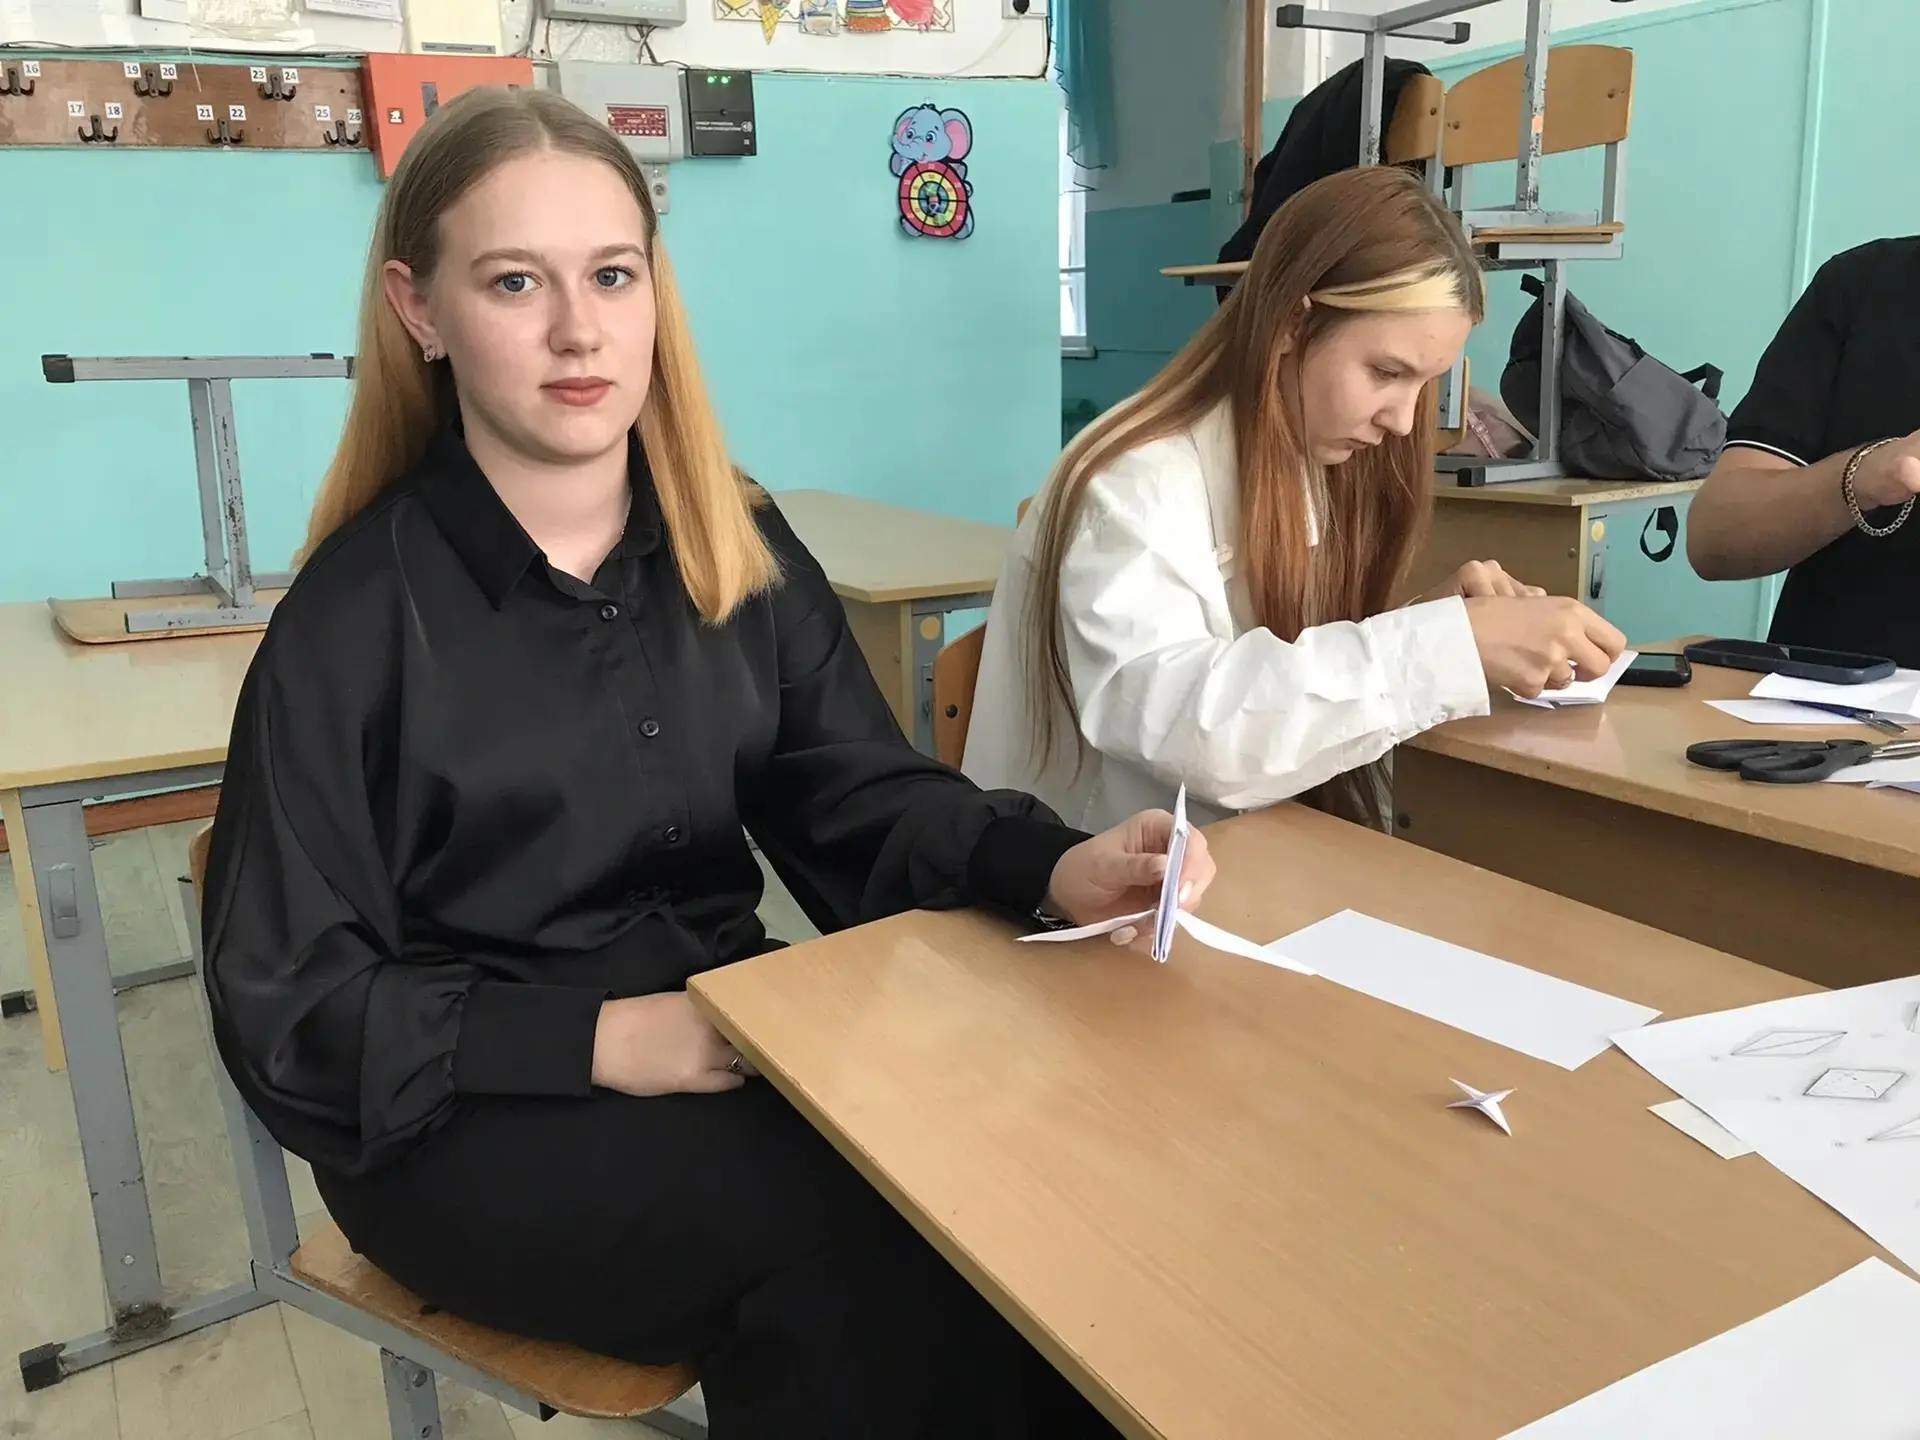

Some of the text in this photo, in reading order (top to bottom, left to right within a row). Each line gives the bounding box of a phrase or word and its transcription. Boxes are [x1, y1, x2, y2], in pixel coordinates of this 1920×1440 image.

[26, 64, 38, 74] 16
[126, 65, 139, 74] 19
[162, 67, 175, 76] 20
[252, 70, 264, 80] 23
[285, 71, 297, 80] 24
[70, 104, 82, 114] 17
[108, 106, 120, 116] 18
[199, 108, 211, 118] 21
[232, 108, 244, 118] 22
[317, 109, 328, 118] 25
[349, 112, 362, 120] 26
